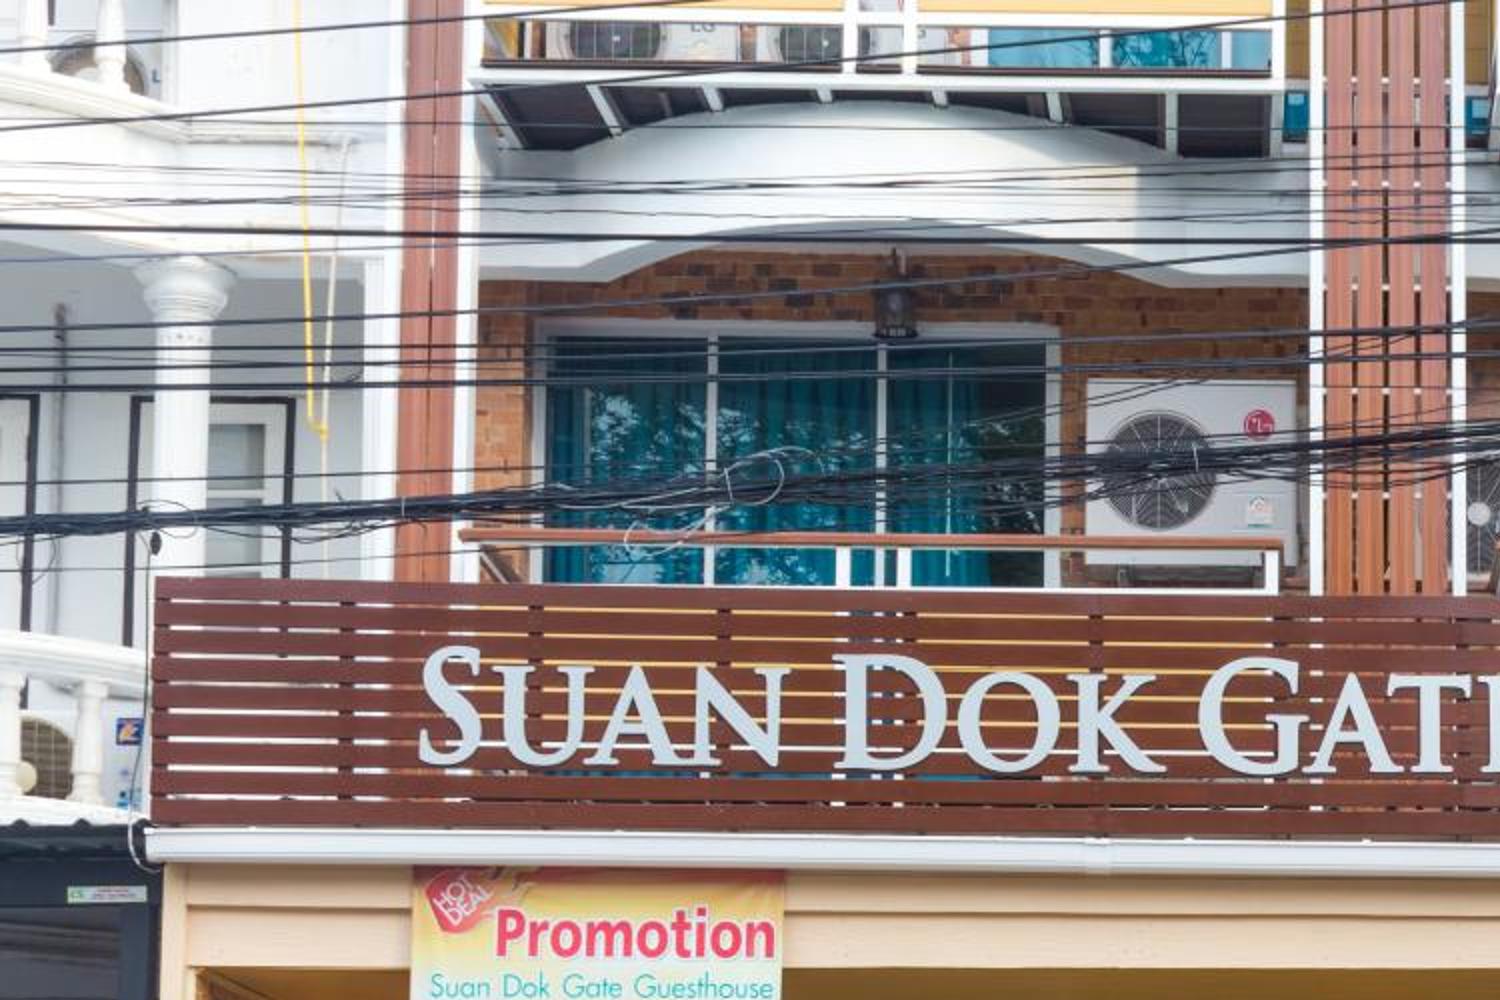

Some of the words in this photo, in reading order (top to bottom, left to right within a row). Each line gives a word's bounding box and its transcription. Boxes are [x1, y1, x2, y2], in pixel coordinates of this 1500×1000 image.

[418, 644, 791, 768] SUAN
[831, 652, 1168, 773] DOK
[433, 875, 475, 912] HOT
[444, 887, 494, 927] DEAL
[494, 905, 776, 960] Promotion
[430, 972, 491, 999] Suan
[503, 970, 550, 999] Dok
[562, 972, 623, 1000] Gate
[633, 969, 775, 1000] Guesthouse
